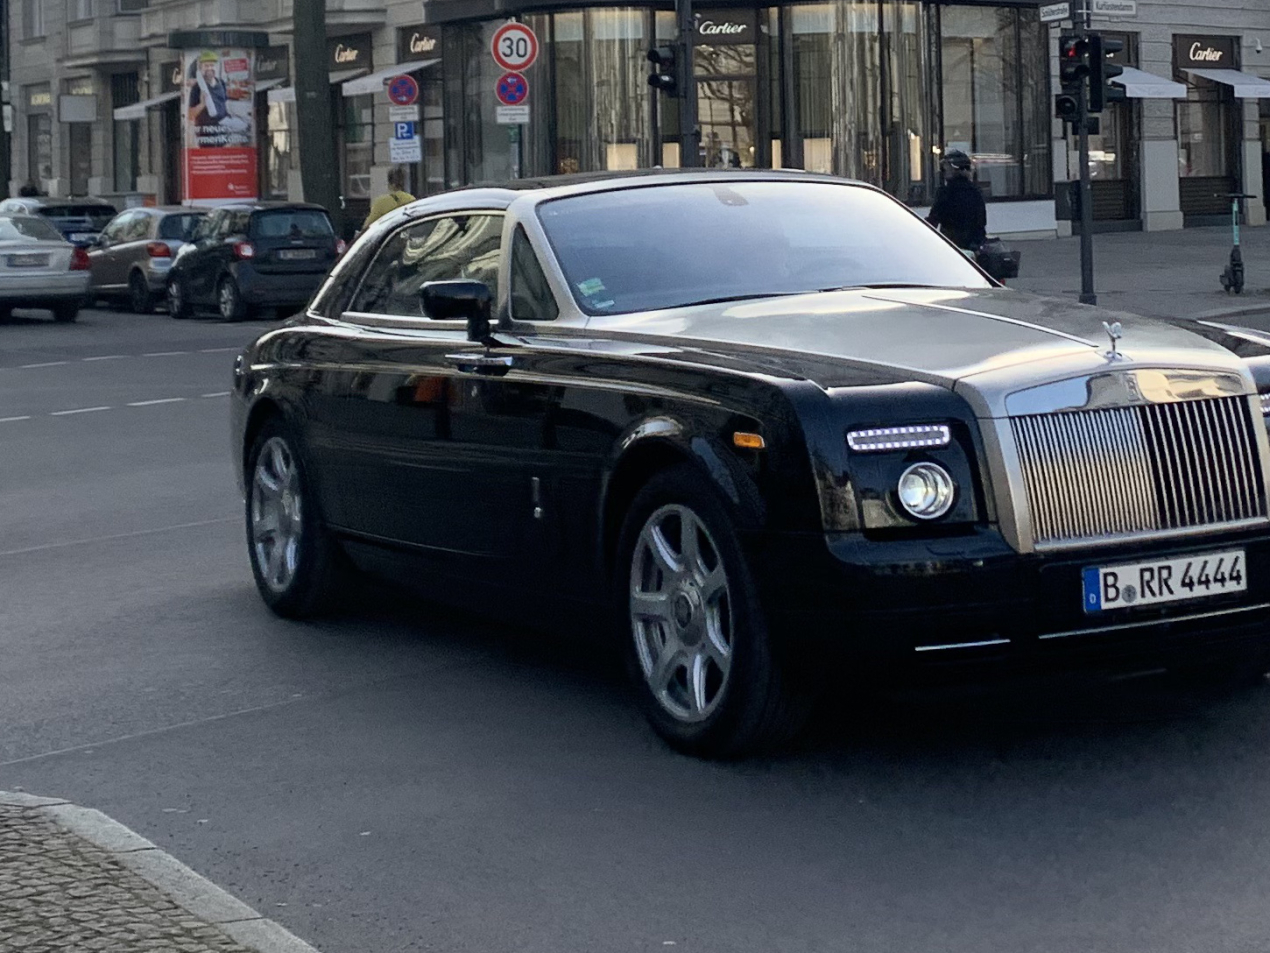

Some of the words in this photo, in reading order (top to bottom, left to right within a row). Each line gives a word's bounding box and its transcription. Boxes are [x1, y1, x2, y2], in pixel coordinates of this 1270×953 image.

[699, 20, 747, 35] Cartier
[334, 43, 359, 64] Cartier
[410, 32, 437, 54] Cartier
[501, 36, 528, 58] 30
[1189, 41, 1223, 62] Cartier
[397, 122, 408, 138] P
[1103, 571, 1120, 603] B
[1139, 565, 1174, 598] RR
[1180, 555, 1243, 592] 4444
